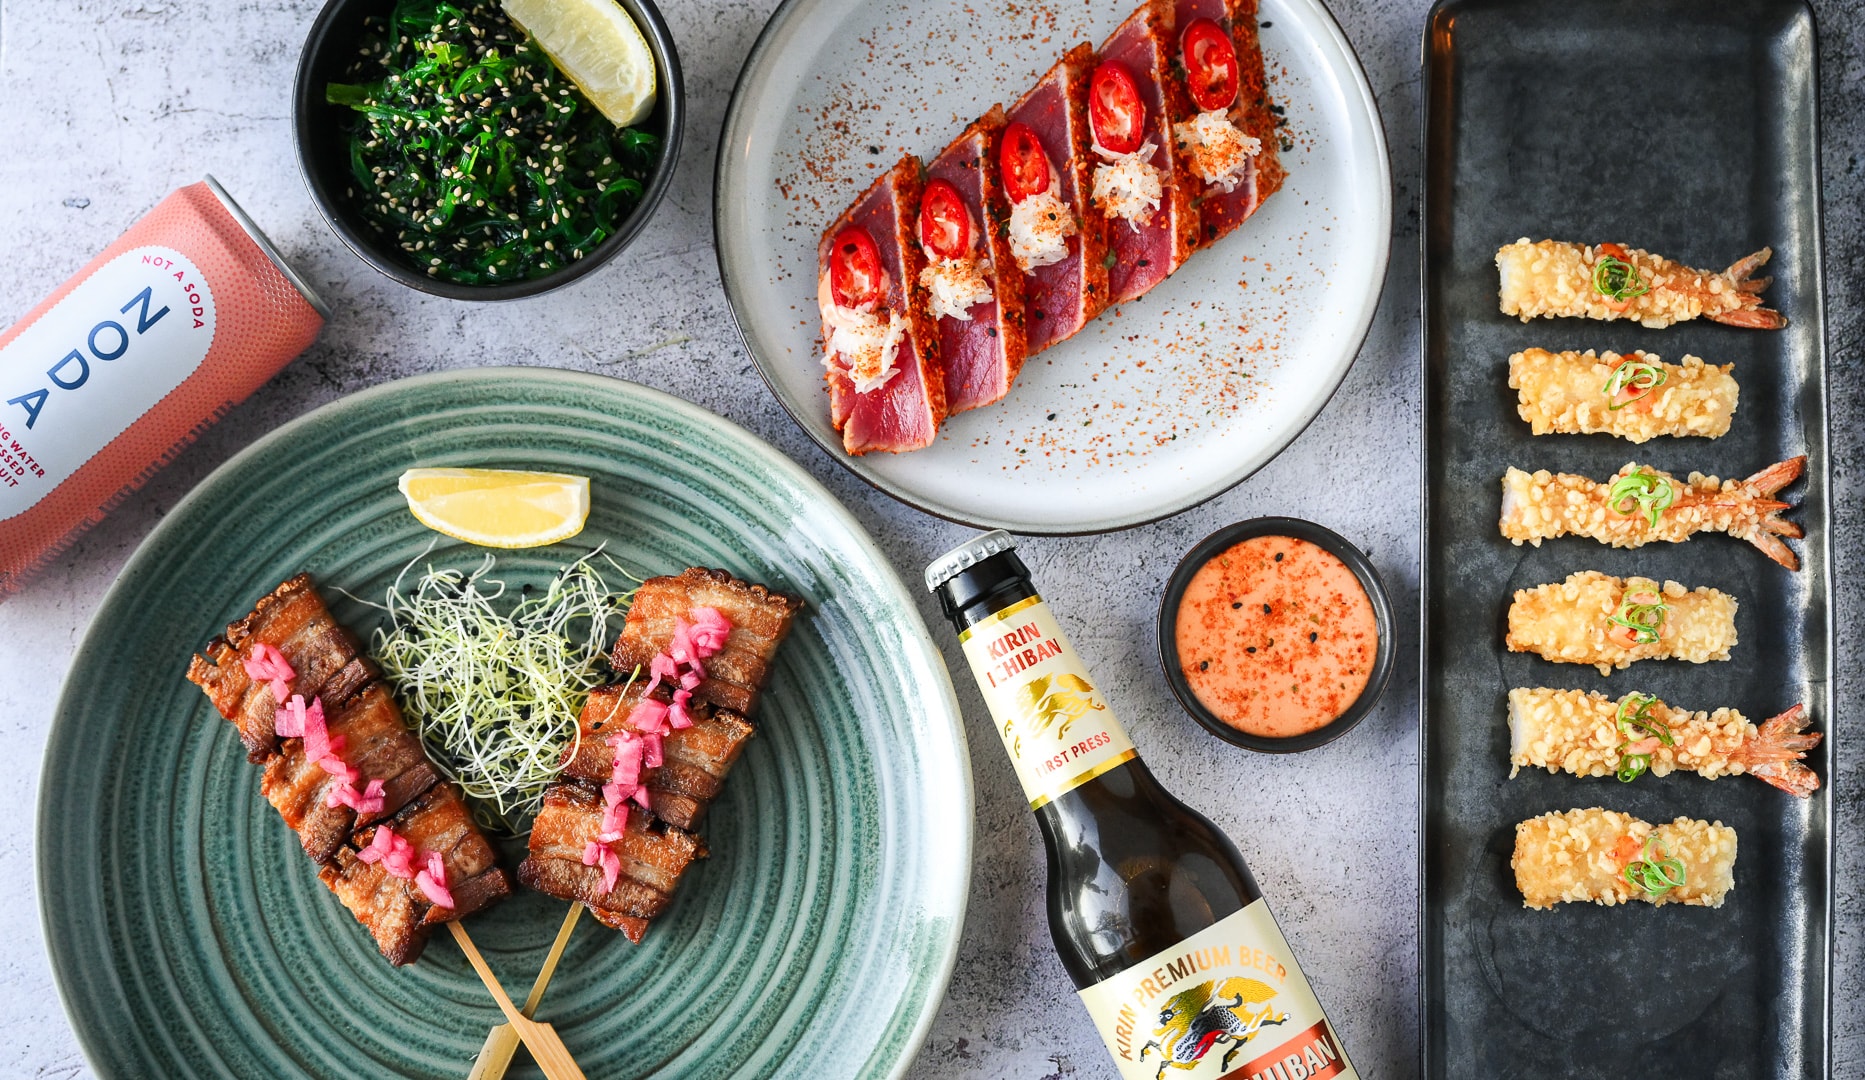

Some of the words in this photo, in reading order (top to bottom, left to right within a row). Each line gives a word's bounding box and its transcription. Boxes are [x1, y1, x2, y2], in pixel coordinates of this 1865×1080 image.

[141, 255, 173, 270] NOT
[173, 271, 184, 282] A
[184, 283, 204, 329] SODA
[6, 286, 171, 430] NODA
[0, 465, 19, 487] UIT
[10, 440, 45, 478] WATER
[986, 621, 1041, 661] KIRIN
[986, 638, 1062, 688] ICHIBAN
[1070, 731, 1111, 758] PRESS
[1116, 1003, 1139, 1061] KIRIN
[1132, 944, 1231, 1008] PREMIUM
[1239, 945, 1287, 984] BEER
